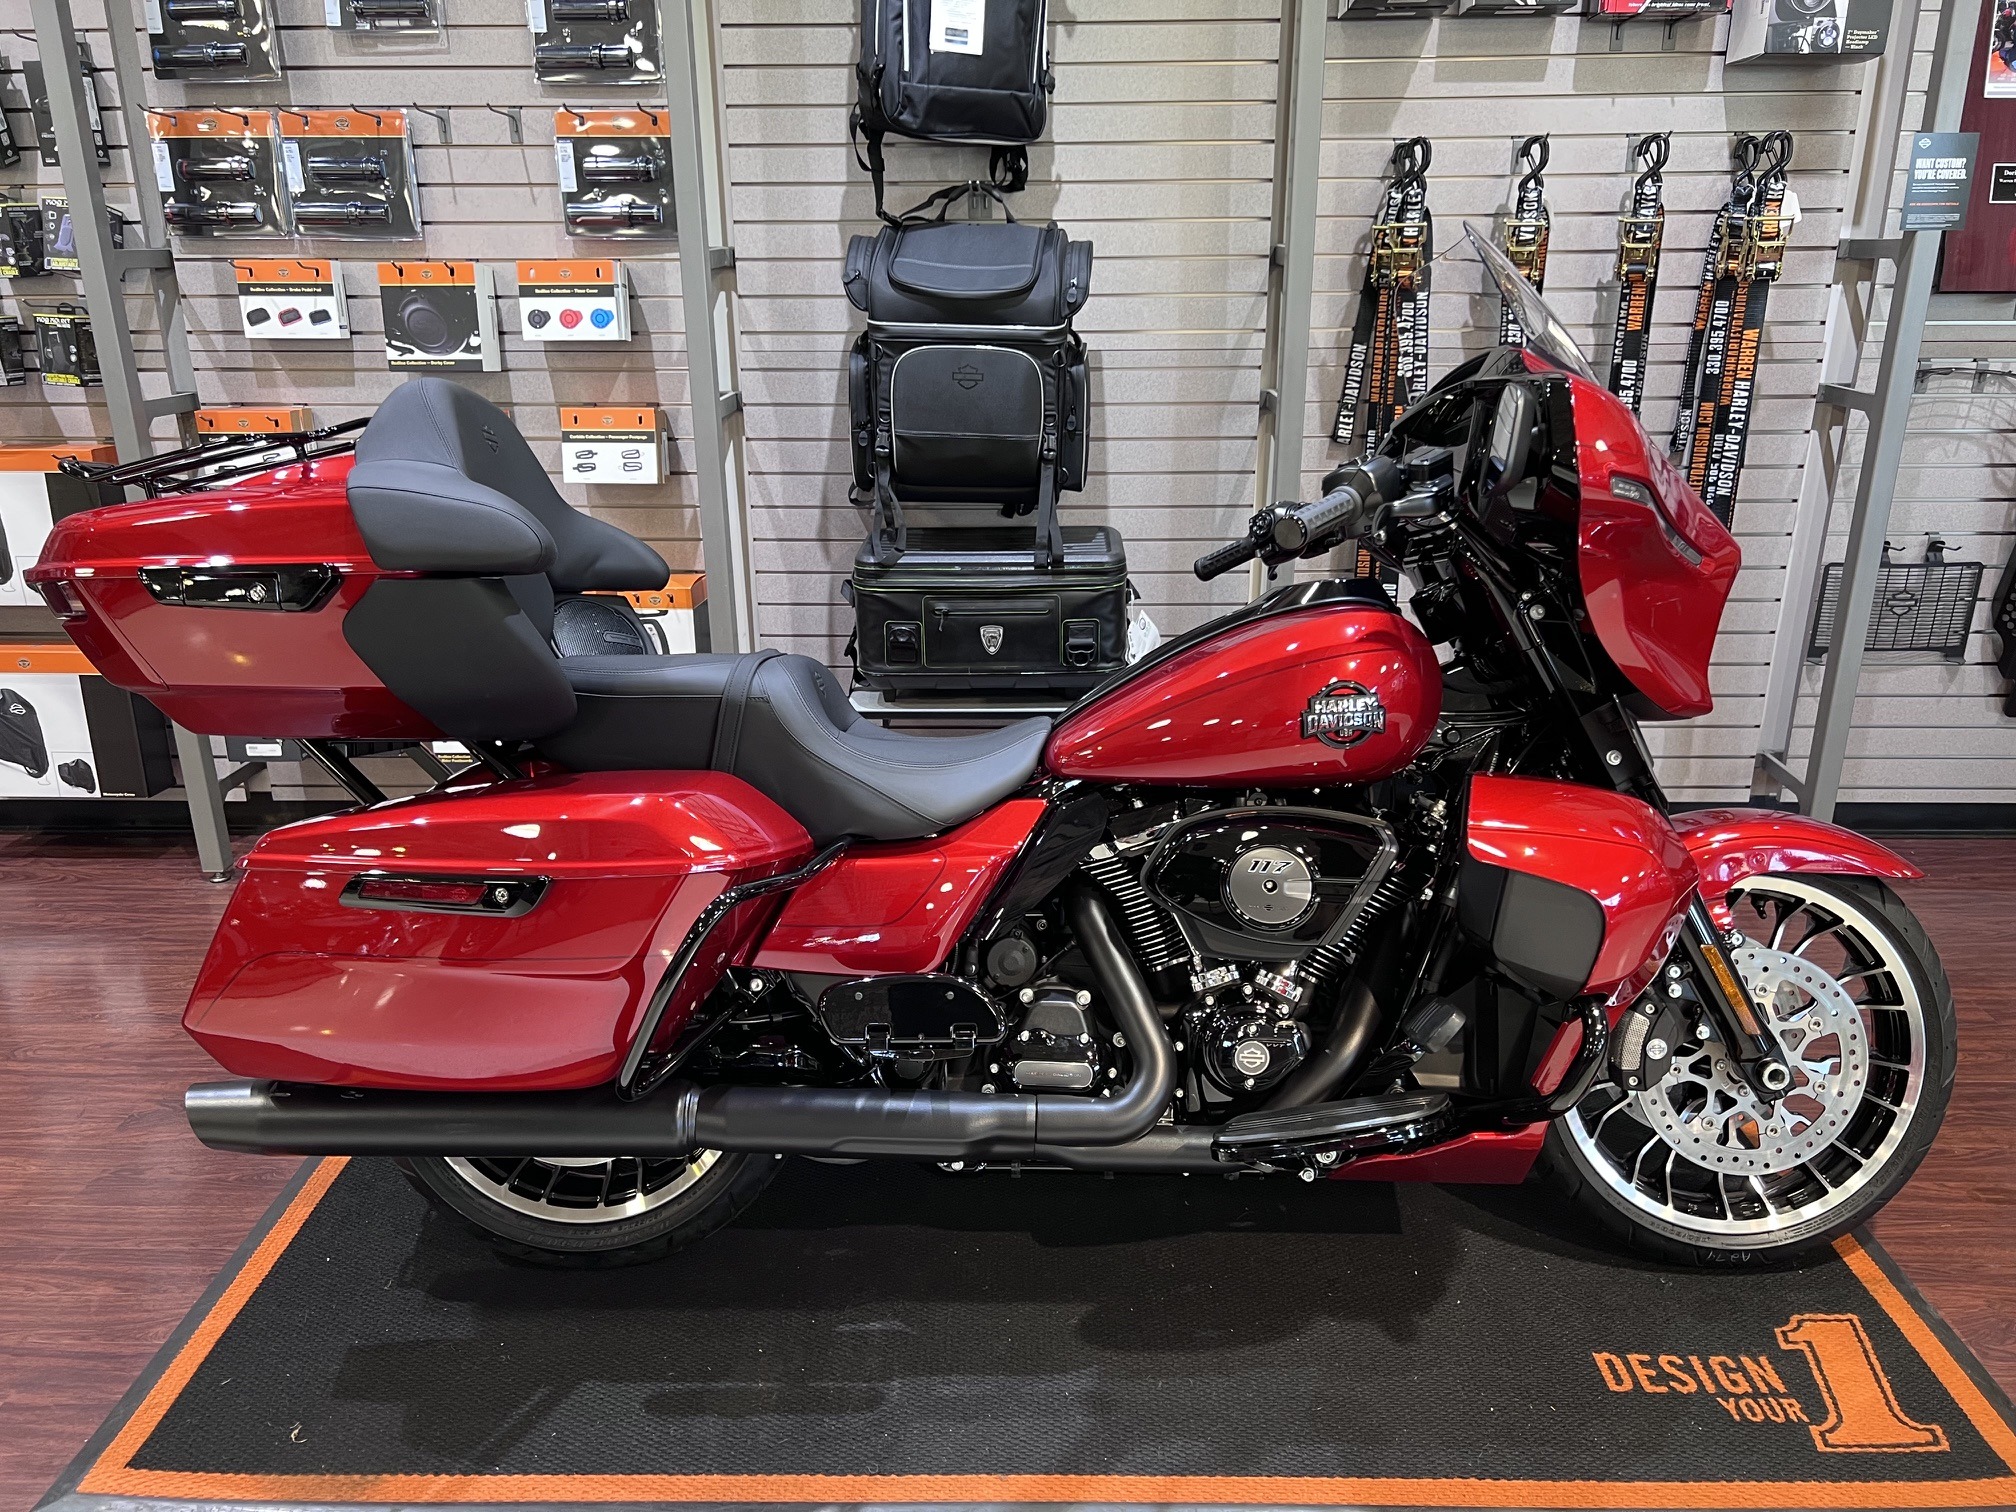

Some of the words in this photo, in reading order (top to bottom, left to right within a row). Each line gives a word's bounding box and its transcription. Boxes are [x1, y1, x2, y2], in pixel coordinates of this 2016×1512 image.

[1914, 168, 1937, 180] YOU'RE
[1915, 157, 1936, 169] WANT
[1935, 157, 1967, 169] CUSTOM?
[1695, 280, 1714, 331] WARREN
[1705, 300, 1730, 376] 330.395.4700
[1736, 328, 1760, 379] WARREN
[1715, 380, 1751, 496] HARLEY-DAVIDSON
[1307, 710, 1385, 735] DAVIDSON
[1247, 858, 1295, 874] 117
[1592, 1351, 1789, 1396] DESIGN
[1774, 1312, 1952, 1454] 1
[1716, 1397, 1811, 1424] YOUR
